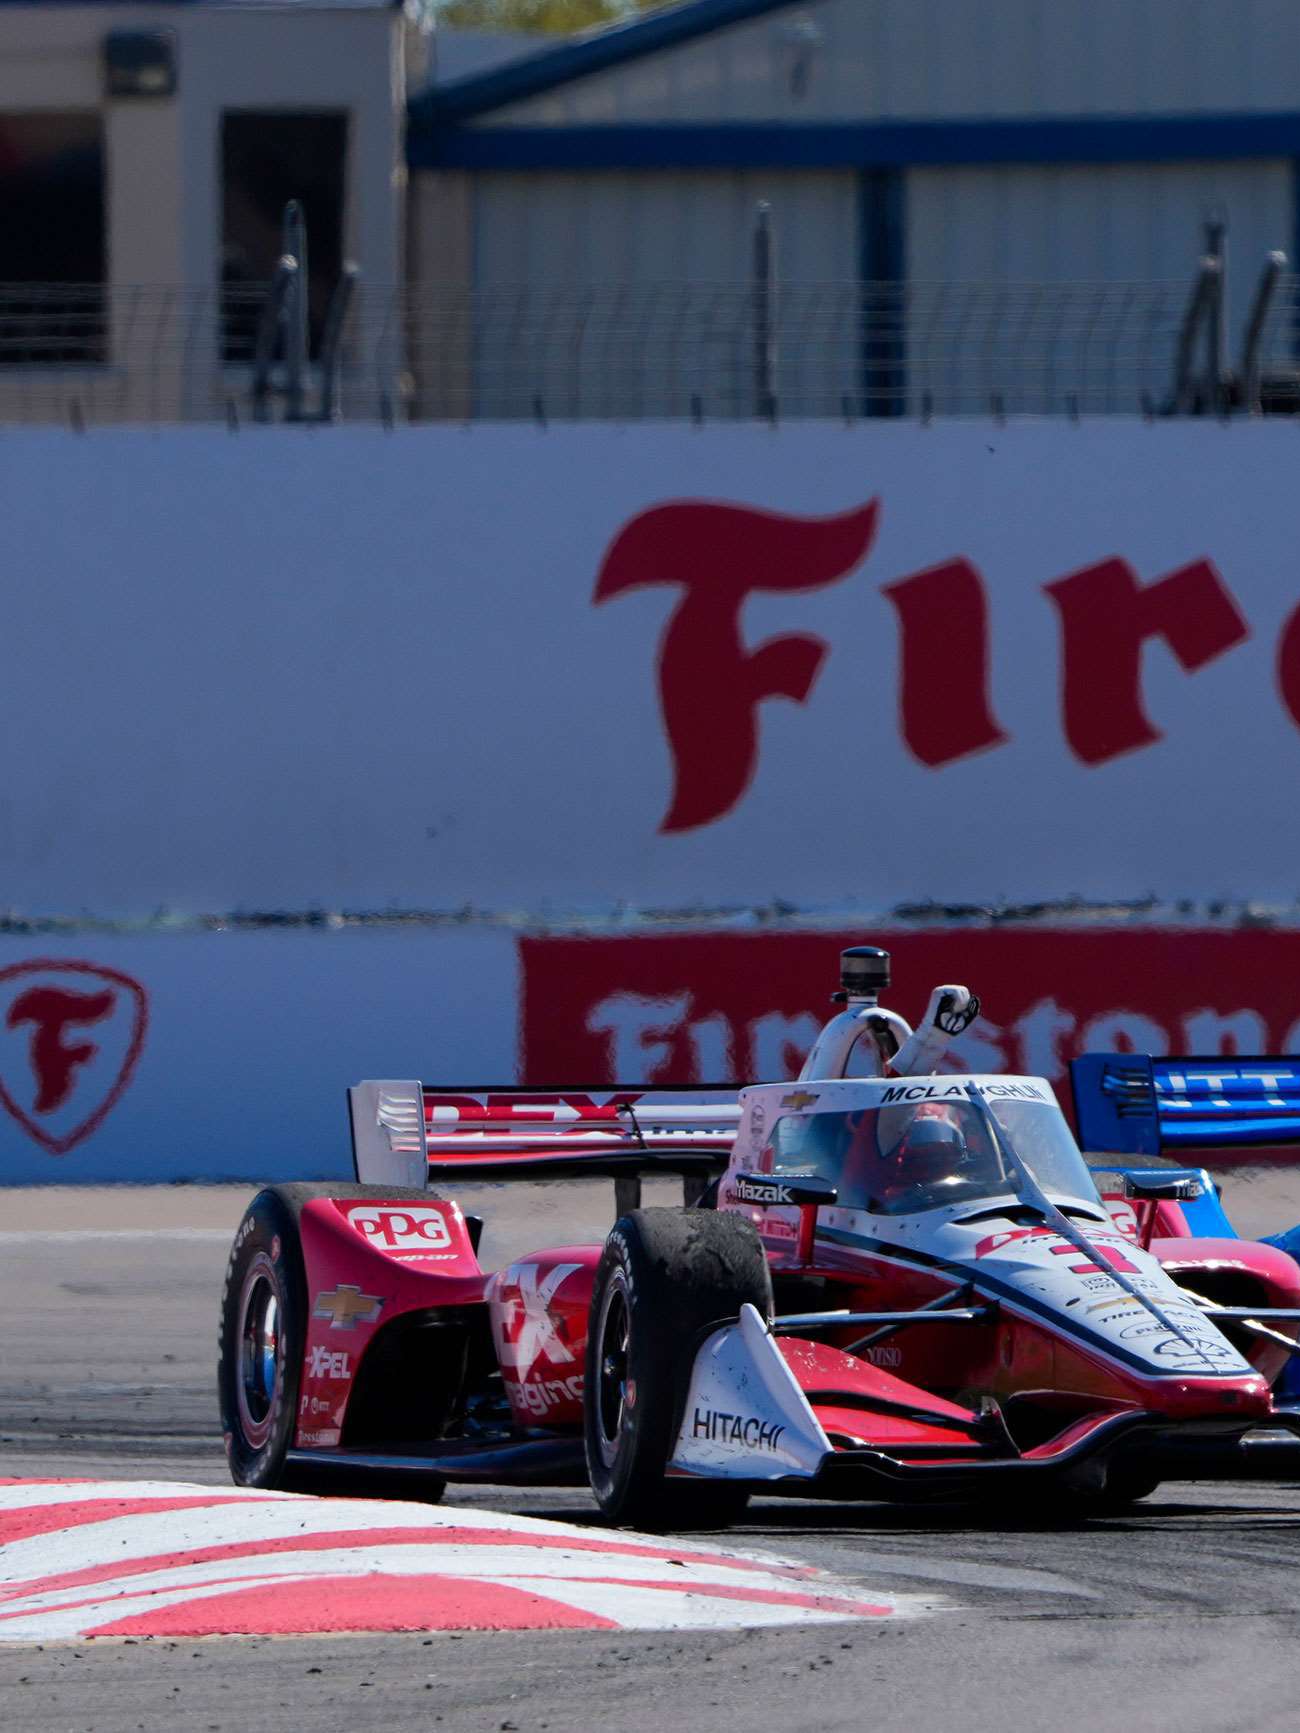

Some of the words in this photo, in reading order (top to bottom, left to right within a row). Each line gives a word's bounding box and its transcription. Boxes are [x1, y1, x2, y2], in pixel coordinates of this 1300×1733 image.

[736, 1179, 793, 1203] Mazak
[354, 1212, 445, 1246] PPG
[1048, 1244, 1142, 1275] 3
[309, 1345, 352, 1379] XPEL
[693, 1407, 786, 1453] HITACHI
